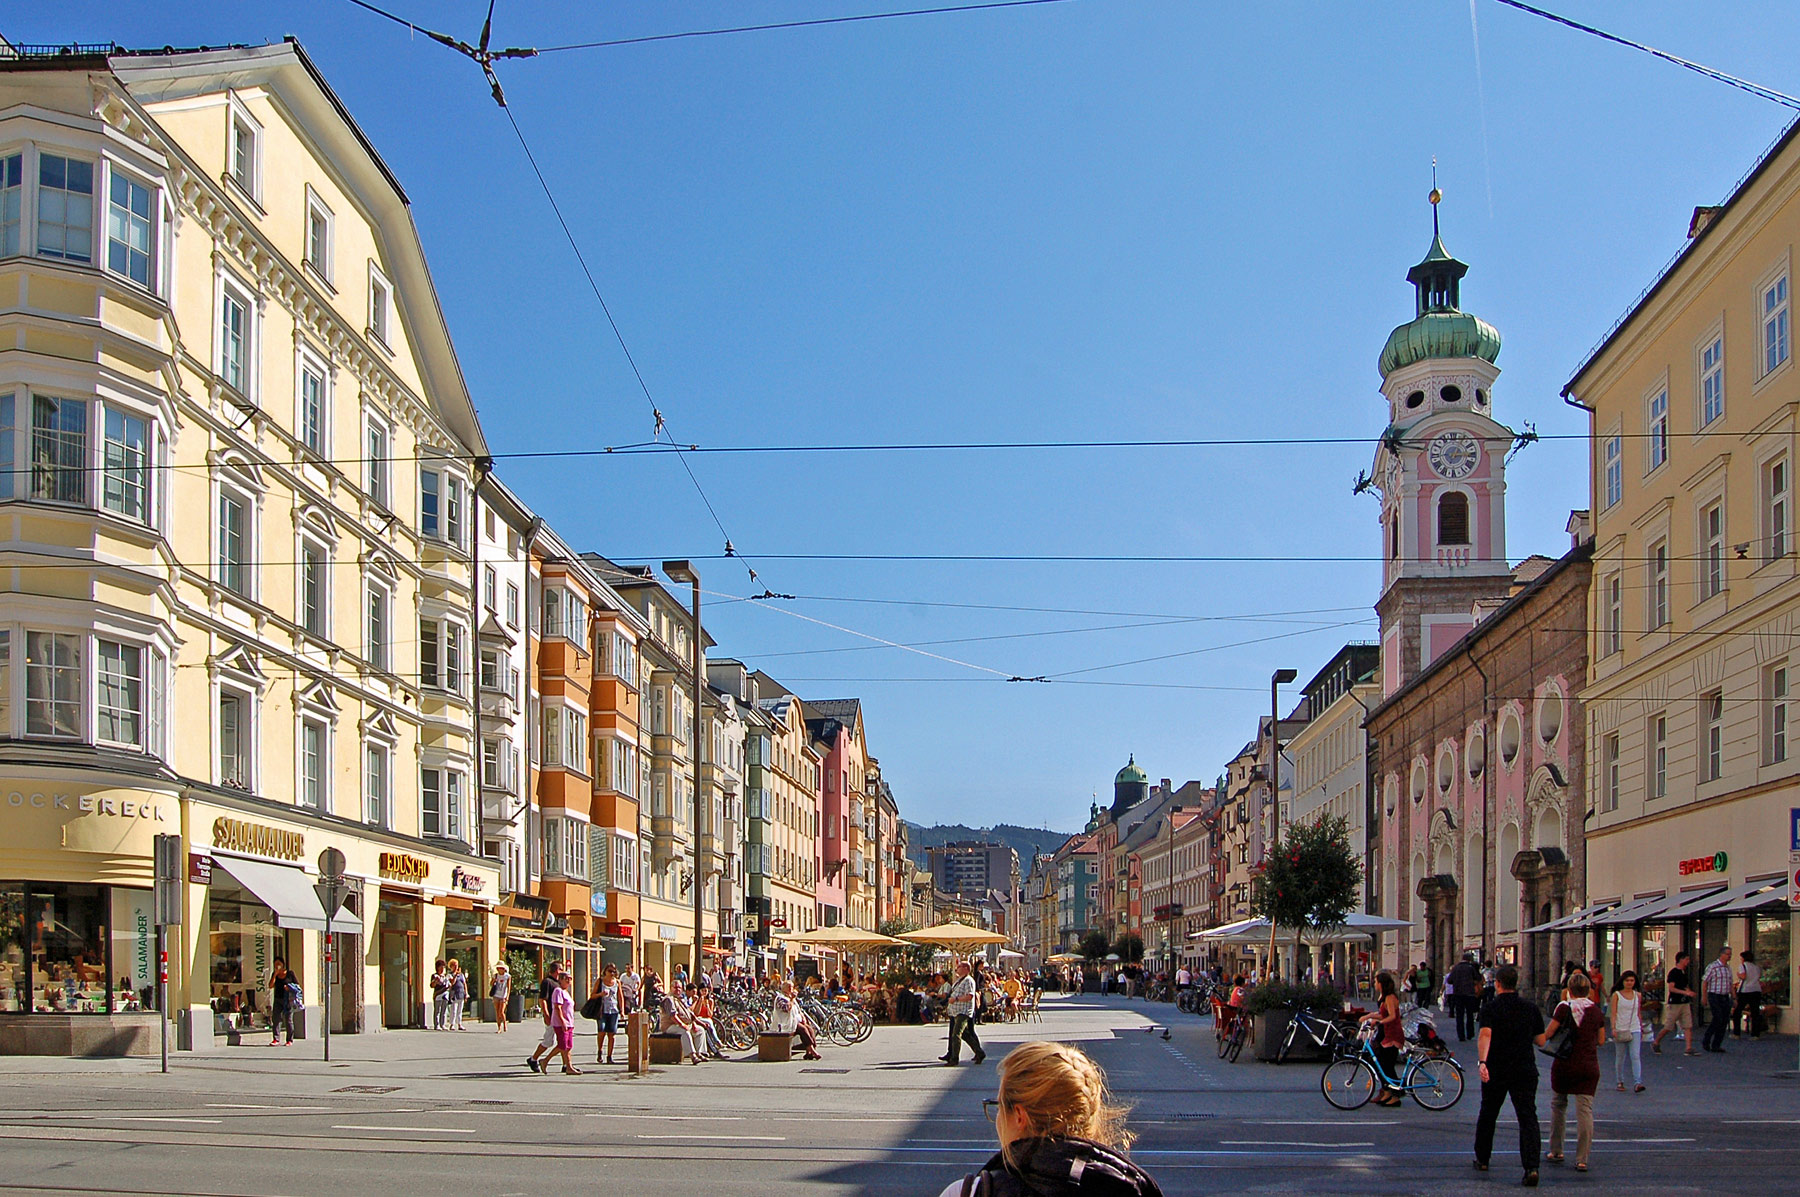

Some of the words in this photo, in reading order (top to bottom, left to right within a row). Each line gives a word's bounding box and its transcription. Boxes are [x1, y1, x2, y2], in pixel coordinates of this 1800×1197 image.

[0, 791, 164, 822] OCKERECK
[214, 816, 305, 857] SALAMANDER
[386, 852, 430, 879] EDUSCHO
[1679, 856, 1715, 875] SPAR
[138, 915, 147, 979] SALAMANDER
[256, 919, 265, 992] SALAMANDER
